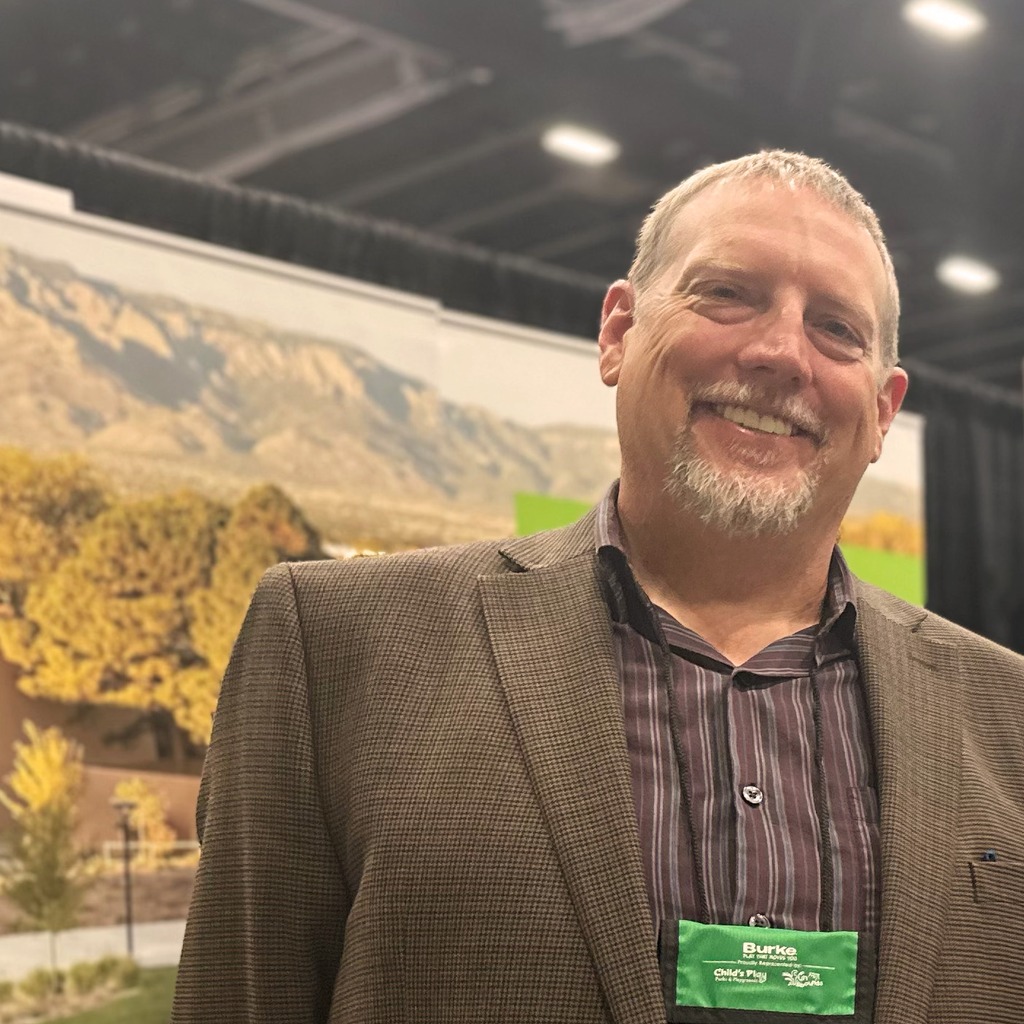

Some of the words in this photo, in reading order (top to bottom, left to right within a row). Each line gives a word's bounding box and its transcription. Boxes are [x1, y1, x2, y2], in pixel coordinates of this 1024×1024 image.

[742, 942, 797, 956] Burke
[714, 968, 744, 977] Child's
[746, 970, 767, 983] Play
